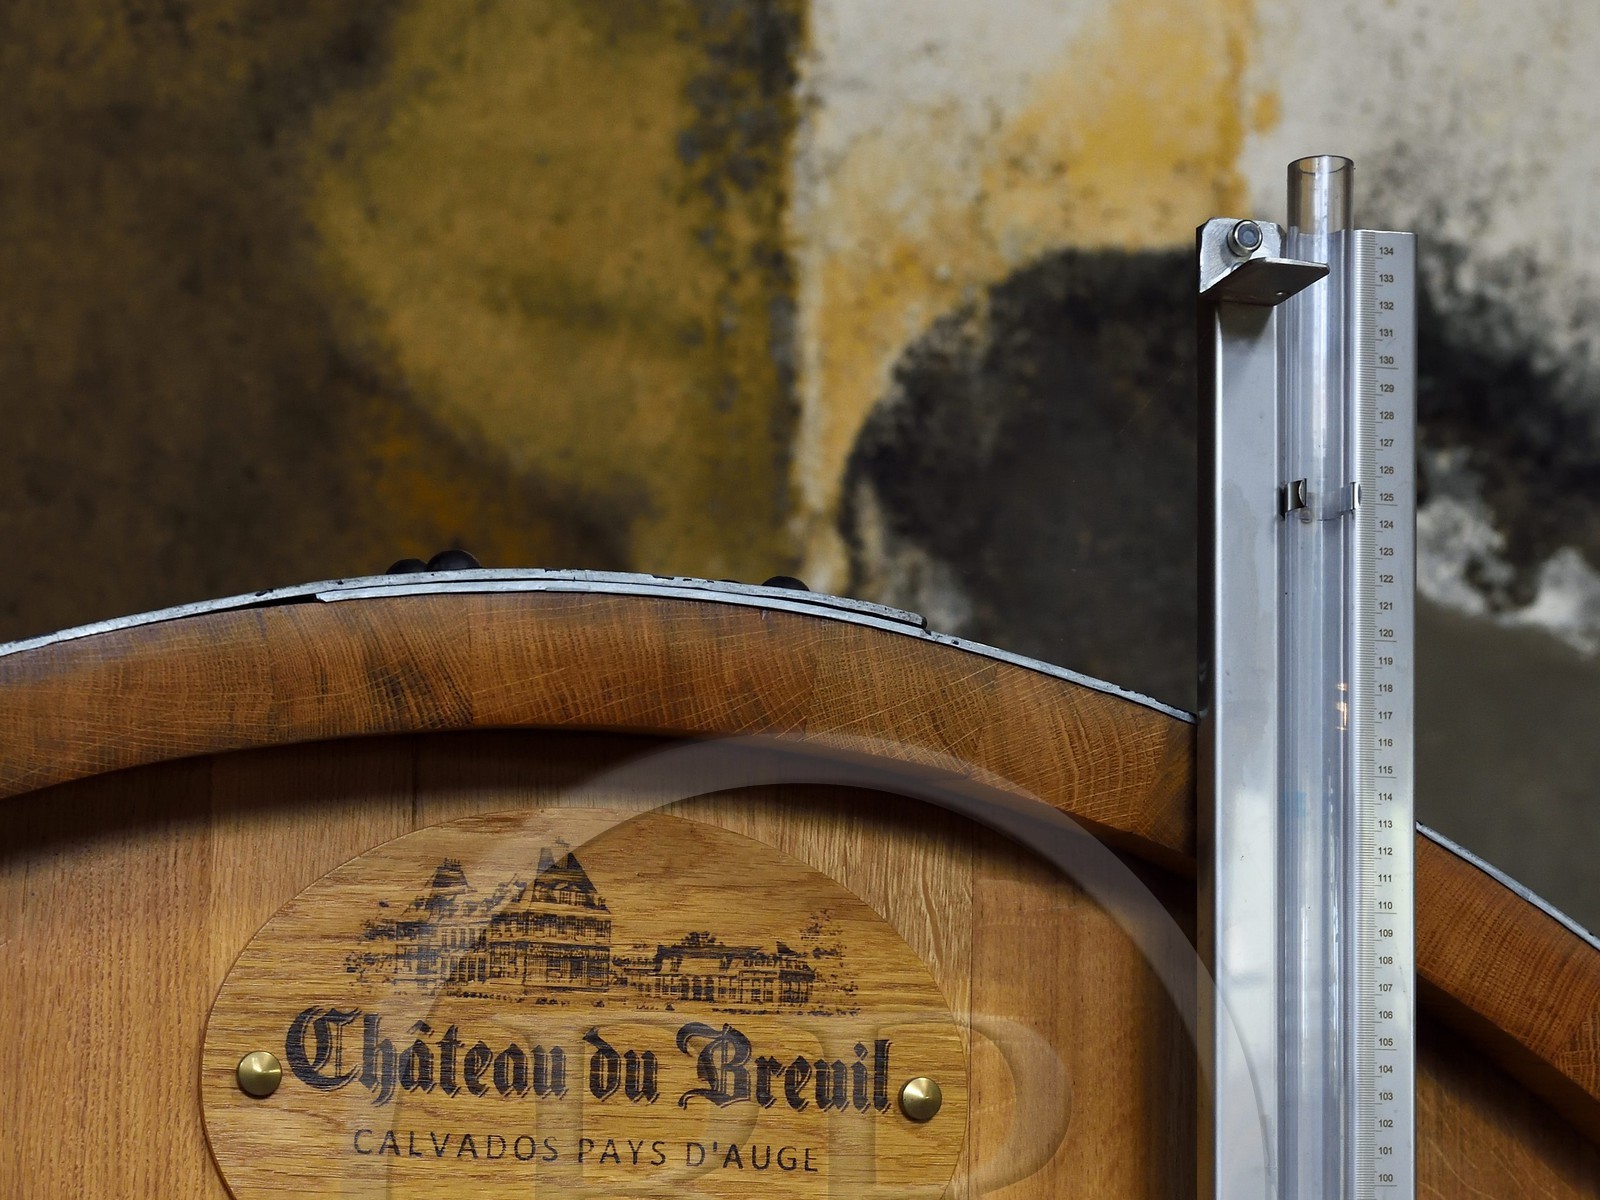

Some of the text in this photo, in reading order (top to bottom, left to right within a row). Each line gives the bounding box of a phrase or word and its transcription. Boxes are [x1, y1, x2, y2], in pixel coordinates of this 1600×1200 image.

[1379, 246, 1394, 256] 134
[1379, 273, 1395, 284] 133
[1379, 301, 1395, 311] 132
[1379, 328, 1394, 338] 131
[1378, 355, 1395, 365] 130
[1379, 383, 1395, 393] 129
[1379, 410, 1395, 421] 128
[1380, 438, 1394, 448] 127
[1379, 465, 1395, 475] 126
[1379, 492, 1395, 502] 125
[1379, 519, 1394, 529] 124
[1379, 546, 1394, 557] 123
[1379, 574, 1394, 584] 122
[1379, 601, 1393, 611] 121
[1378, 628, 1394, 638] 120
[1378, 656, 1394, 666] 119
[1378, 683, 1394, 693] 118
[1378, 711, 1393, 720] 117
[1379, 738, 1393, 747] 116
[1378, 765, 1393, 775] 115
[1378, 792, 1393, 802] 114
[1378, 819, 1393, 829] 113
[1378, 846, 1393, 856] 112
[1378, 874, 1392, 883] 111
[1378, 901, 1393, 910] 110
[1378, 928, 1394, 938] 109
[1378, 955, 1394, 965] 108
[1378, 983, 1393, 992] 107
[1378, 1010, 1394, 1020] 106
[1378, 1037, 1394, 1047] 105
[284, 1004, 893, 1115] Château du Breuil
[1379, 1064, 1393, 1074] 104
[1379, 1091, 1394, 1101] 103
[1378, 1119, 1394, 1128] 102
[353, 1127, 820, 1173] CALVADOS PAYS D'AUGE
[1378, 1146, 1393, 1156] 101
[1378, 1173, 1394, 1183] 100
